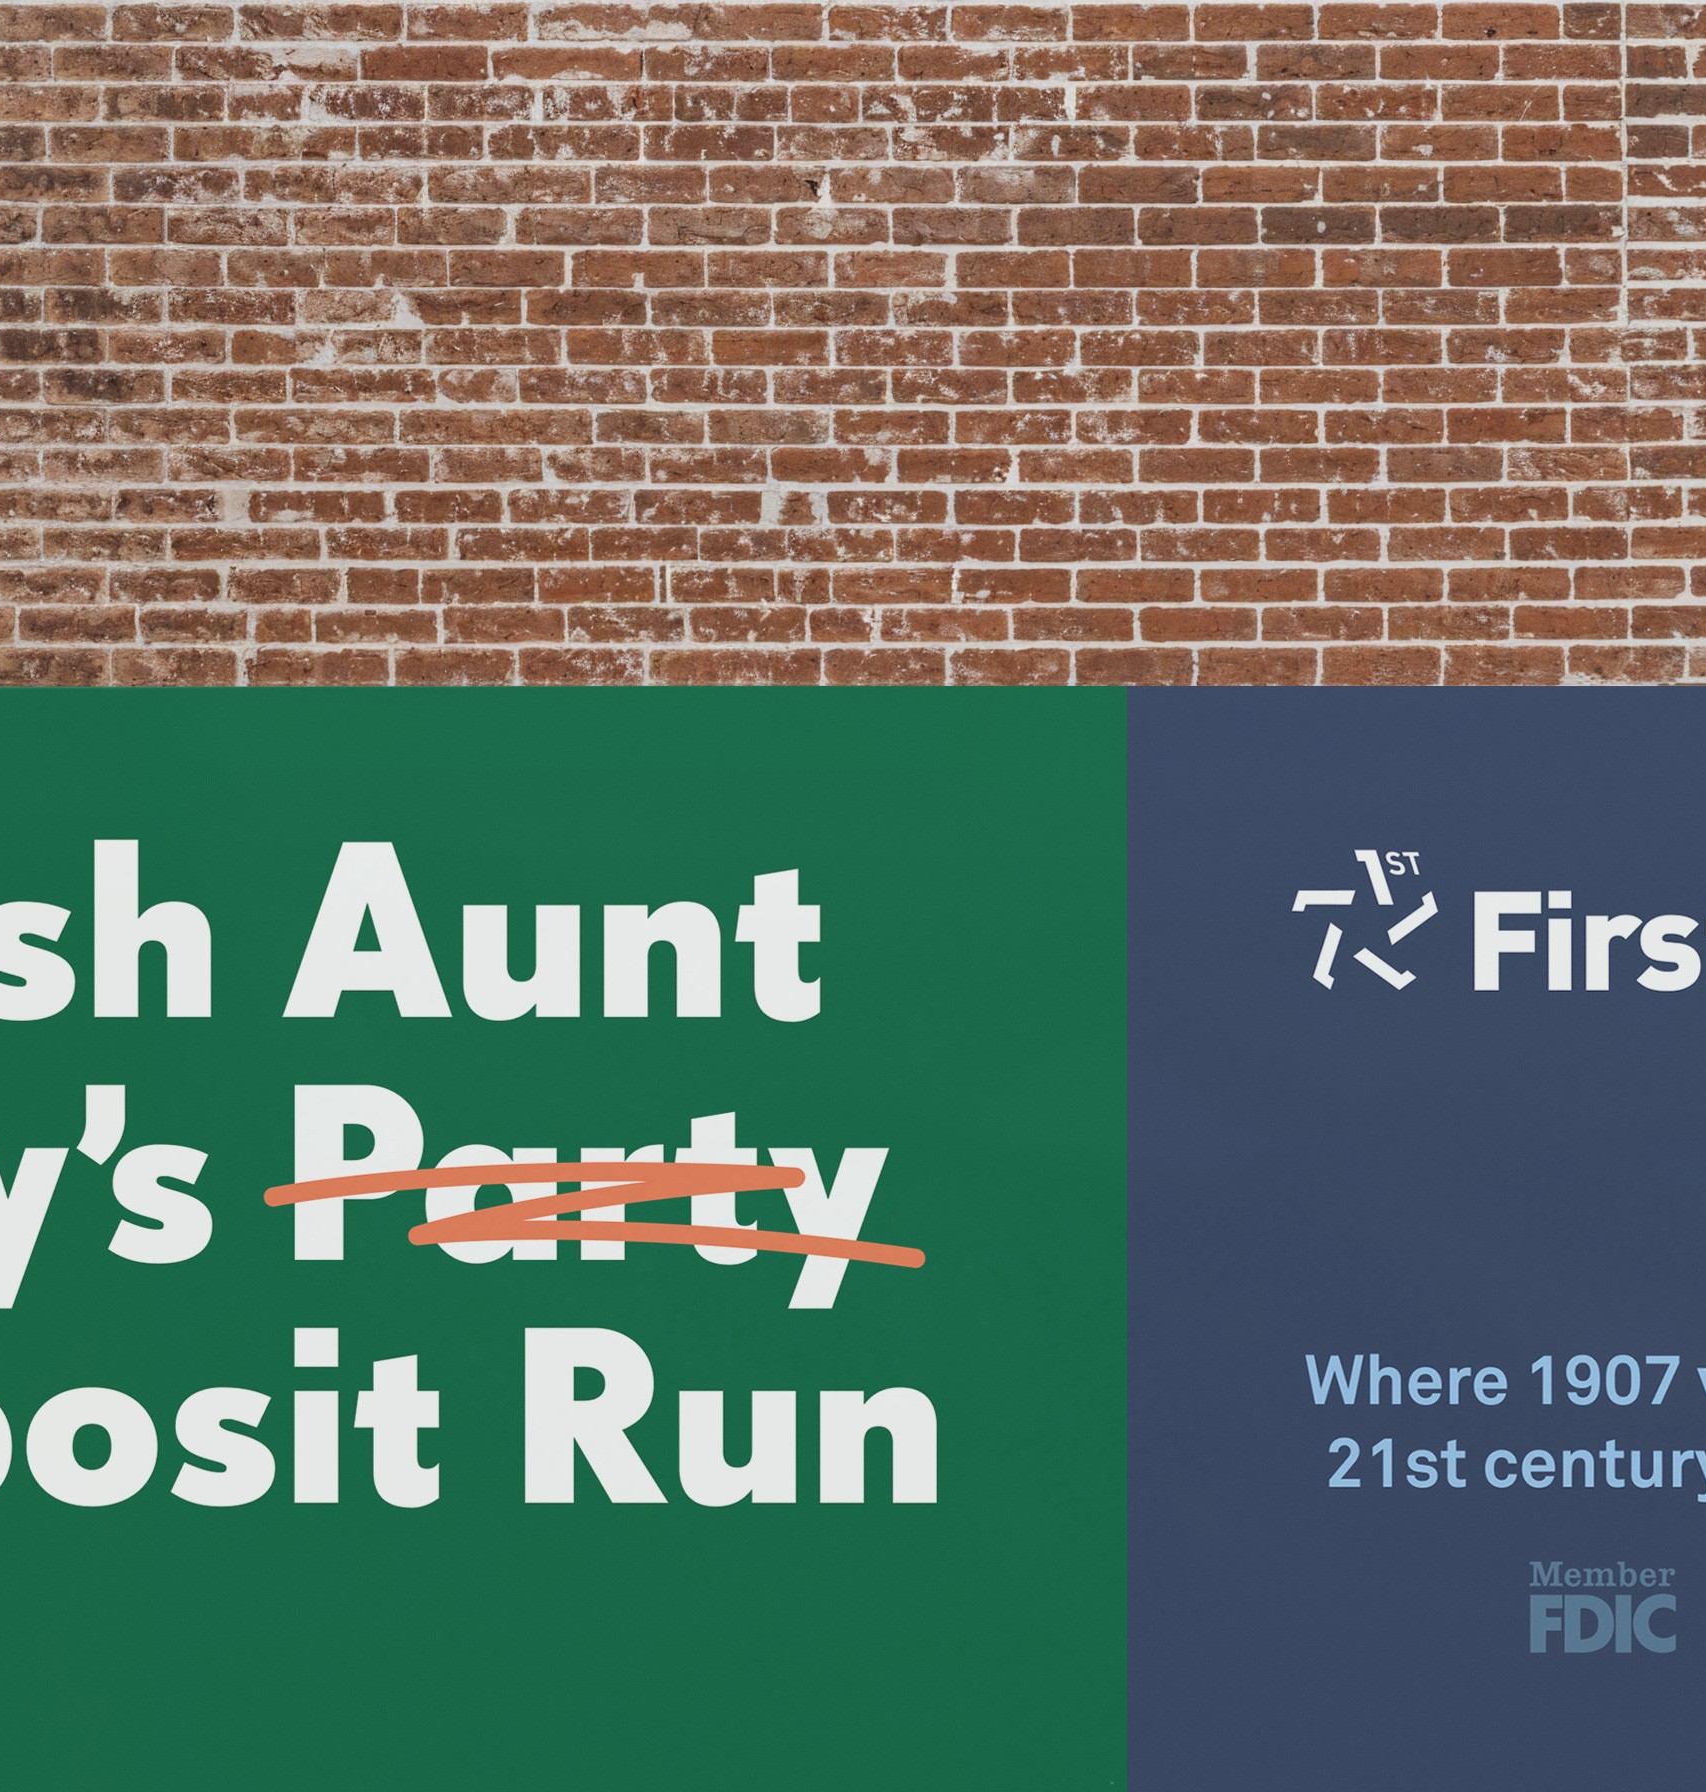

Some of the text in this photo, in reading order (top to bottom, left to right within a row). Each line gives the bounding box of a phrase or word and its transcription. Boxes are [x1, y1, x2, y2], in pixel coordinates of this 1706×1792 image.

[282, 842, 820, 1023] Aunt
[294, 1084, 890, 1309] Party
[1305, 1354, 1507, 1405] Where
[1531, 1355, 1681, 1406] 1907
[525, 1327, 937, 1508] Run
[1329, 1438, 1467, 1488] 21st
[1529, 1561, 1675, 1587] Member
[1529, 1594, 1676, 1653] FDIC
